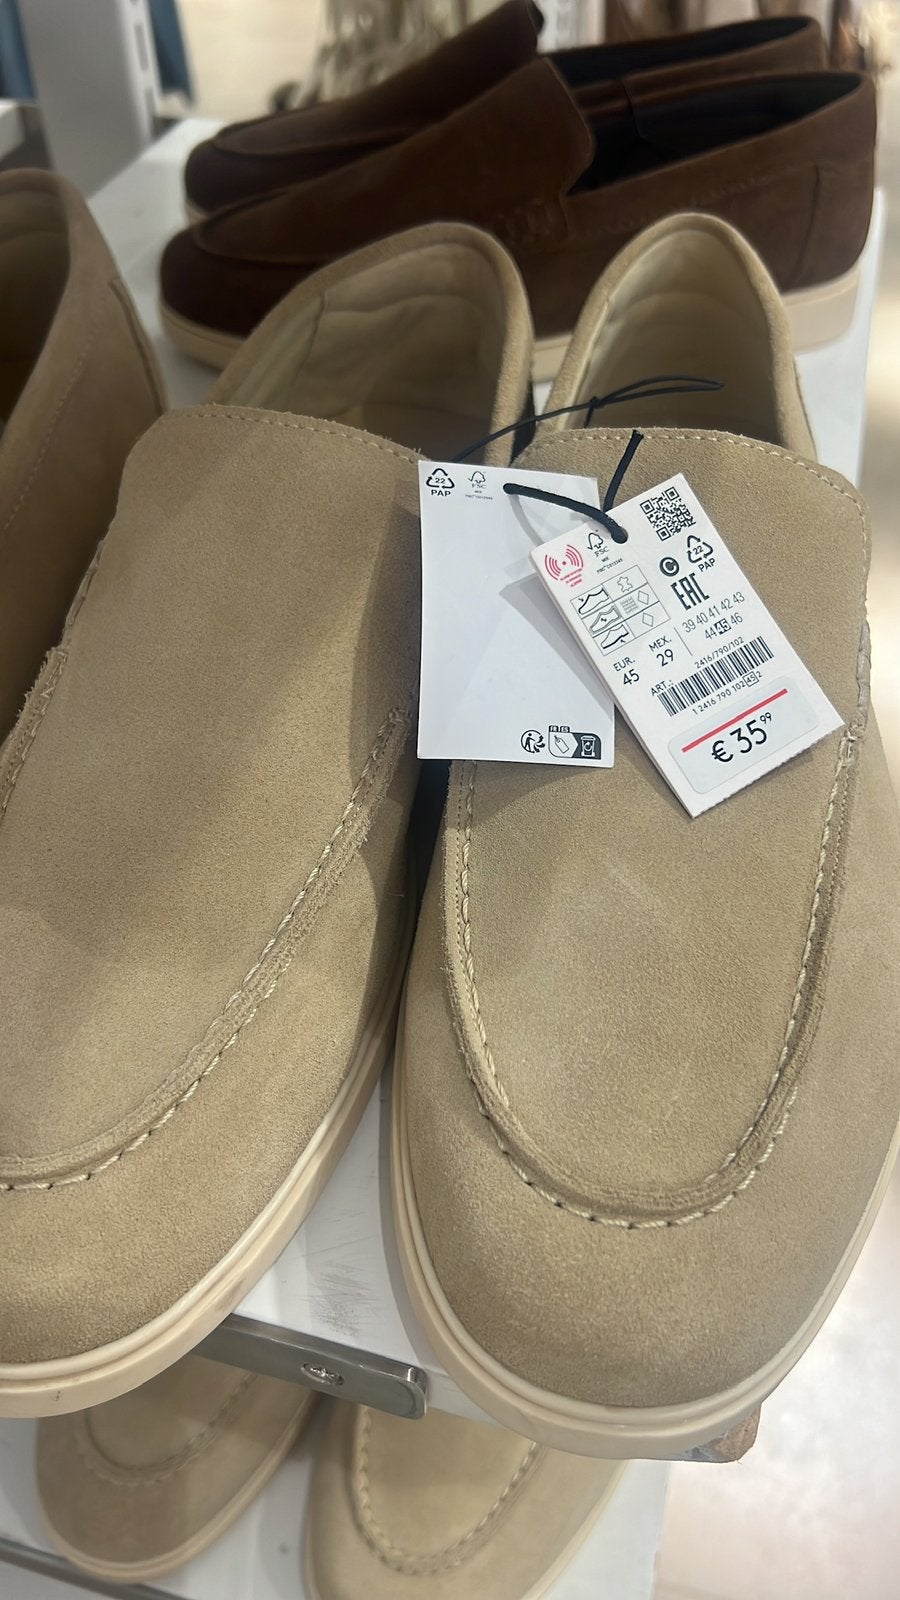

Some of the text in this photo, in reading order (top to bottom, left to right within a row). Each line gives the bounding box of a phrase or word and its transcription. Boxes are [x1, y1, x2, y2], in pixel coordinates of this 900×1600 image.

[594, 546, 609, 557] FSC
[692, 545, 704, 555] 22
[698, 558, 716, 572] PAP
[682, 592, 745, 633] 39 40 41 42 43
[704, 612, 744, 640] 44 45 46
[648, 635, 672, 652] MEX.
[694, 636, 744, 669] 2416/790/102
[613, 656, 636, 672] EUR.
[656, 648, 674, 667] 29
[622, 668, 640, 686] 45
[698, 698, 716, 712] 2416
[716, 688, 732, 701] 790
[732, 681, 746, 692] 102
[712, 740, 734, 762] €
